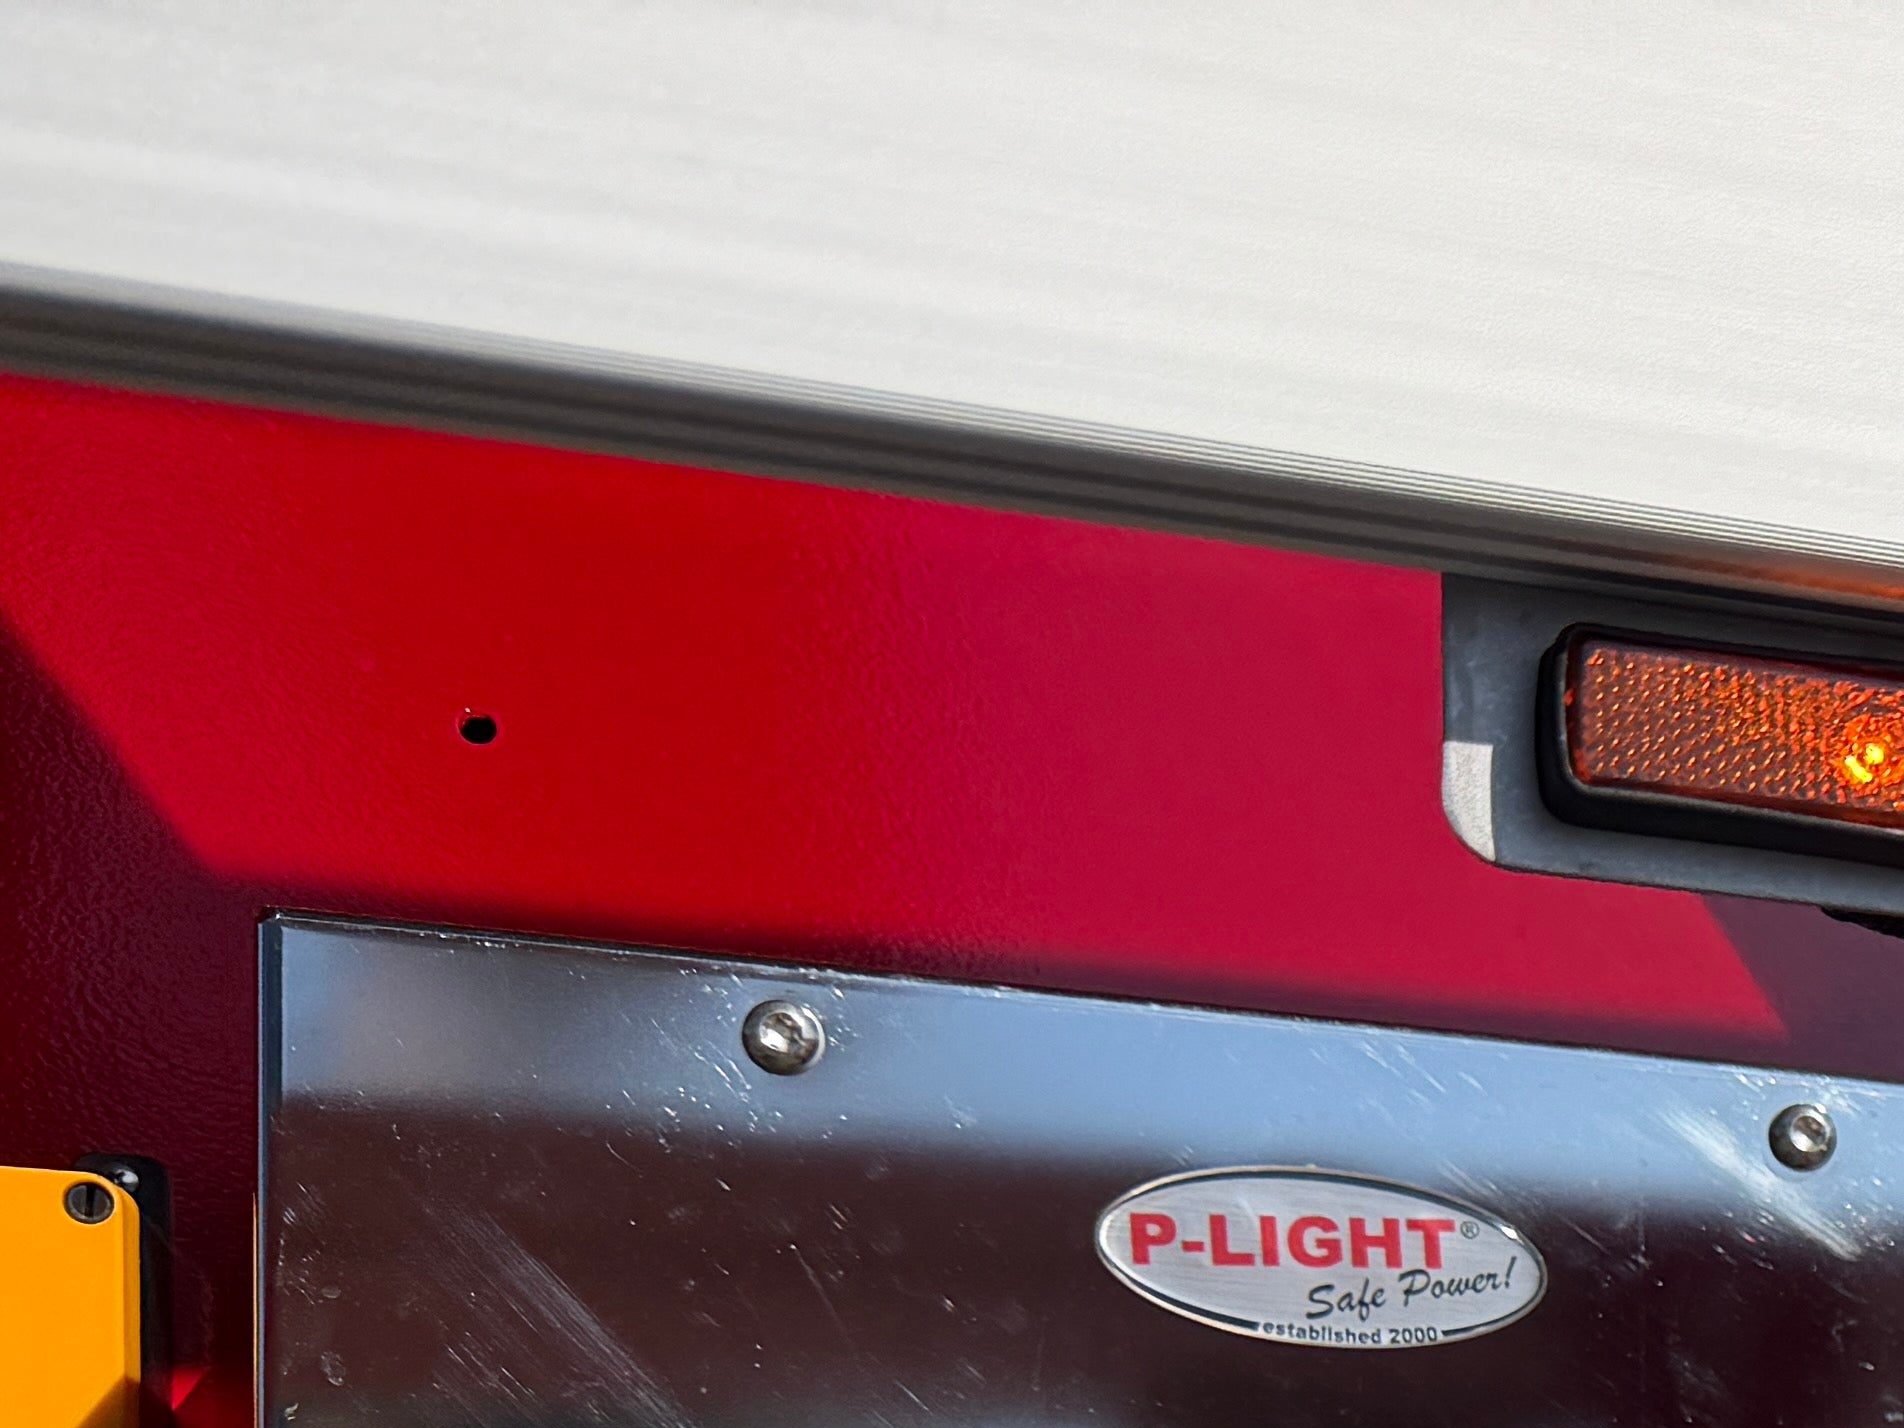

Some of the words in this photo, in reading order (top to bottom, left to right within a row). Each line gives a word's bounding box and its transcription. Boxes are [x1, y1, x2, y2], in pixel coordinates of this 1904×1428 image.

[1305, 1278, 1385, 1321] Safe
[1399, 1256, 1517, 1307] Power!
[1263, 1321, 1382, 1345] established
[1389, 1327, 1438, 1345] 2000
